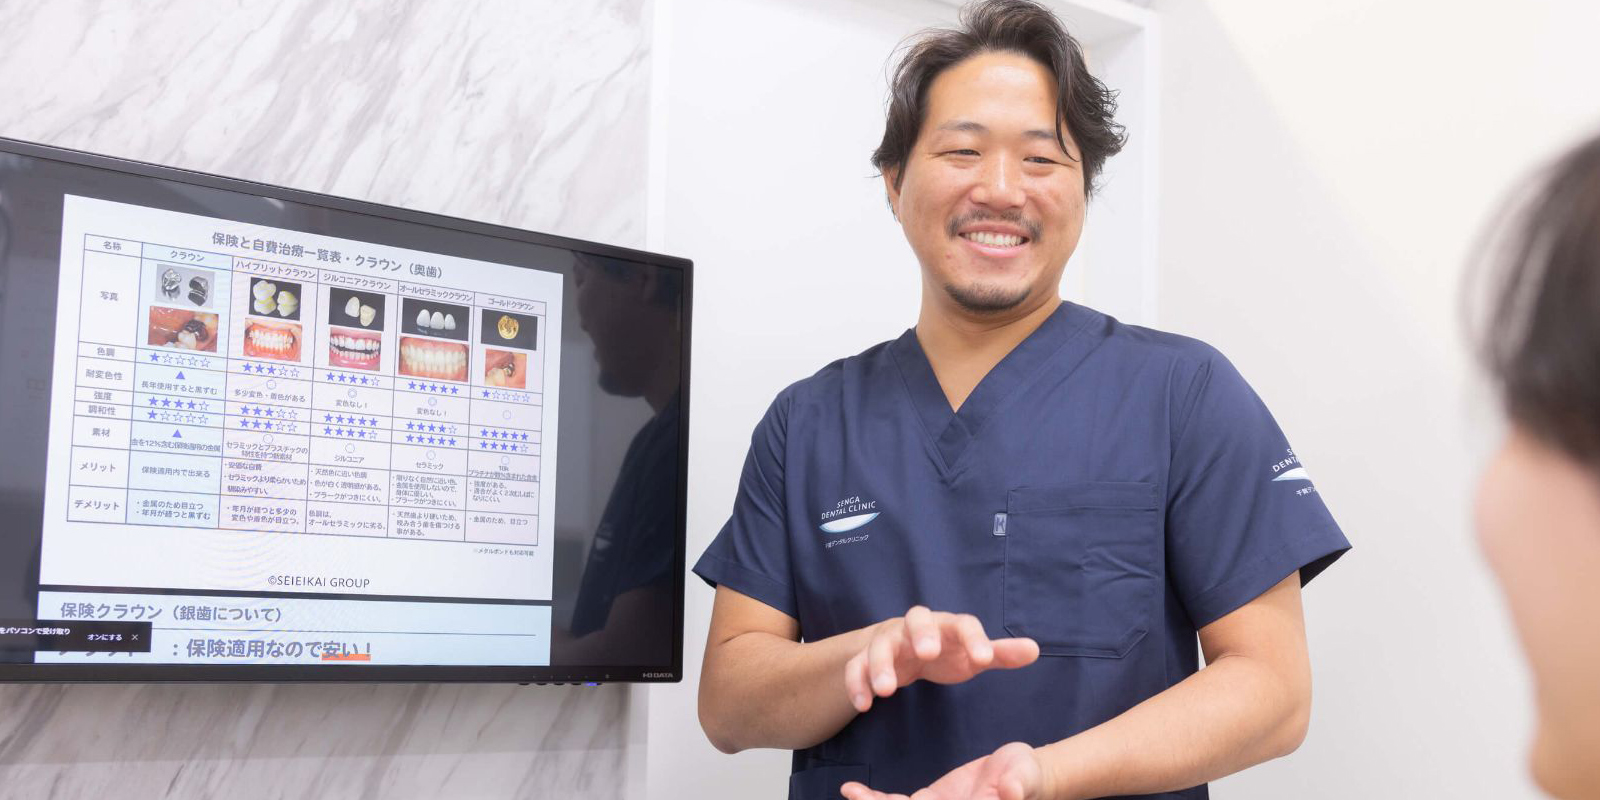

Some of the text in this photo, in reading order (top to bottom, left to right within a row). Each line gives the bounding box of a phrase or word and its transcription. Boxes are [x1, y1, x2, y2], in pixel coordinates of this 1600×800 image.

[102, 240, 122, 252] 名称
[170, 249, 205, 263] クラウン
[212, 231, 443, 279] 保険と自費治療一覧表・クラウン（奥歯）
[323, 272, 391, 290] ジルコニアクラウン
[100, 290, 119, 302] 写真
[97, 346, 115, 358] 色調
[85, 368, 123, 381] 耐変色性
[141, 380, 218, 396] 長年使用すると黒ずむ
[94, 391, 112, 402] 強度
[88, 404, 117, 416] 調和性
[92, 427, 110, 438] 素材
[79, 461, 117, 474] メリット
[73, 499, 120, 512] デメリット
[837, 496, 860, 509] SENGA
[821, 500, 876, 520] DENTAL CLINIC
[330, 577, 370, 589] GROUP
[60, 601, 283, 623] 保険クラウン（銀歯について）
[87, 633, 123, 641] オンにする
